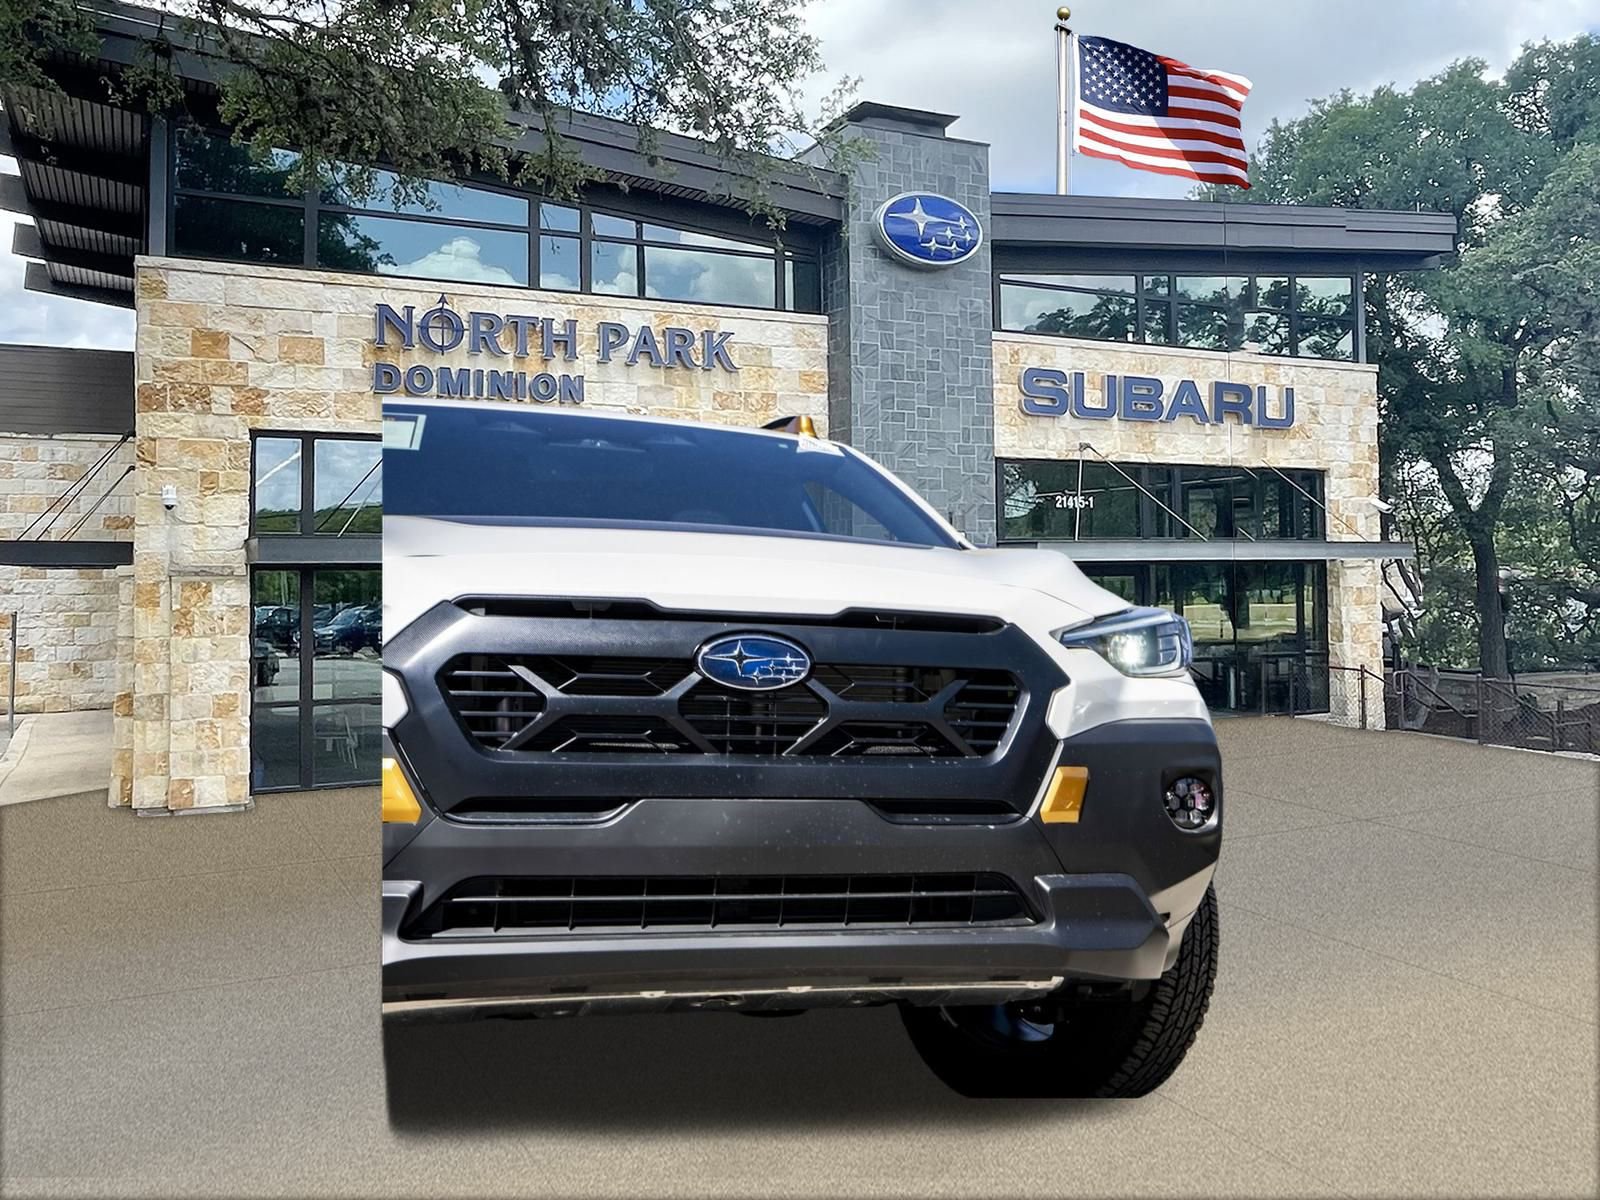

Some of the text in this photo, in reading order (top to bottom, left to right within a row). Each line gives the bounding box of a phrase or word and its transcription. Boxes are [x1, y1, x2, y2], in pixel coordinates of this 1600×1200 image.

[375, 294, 741, 373] NORTH PARK
[373, 362, 585, 404] DOMINION
[1019, 367, 1295, 429] SUBARU
